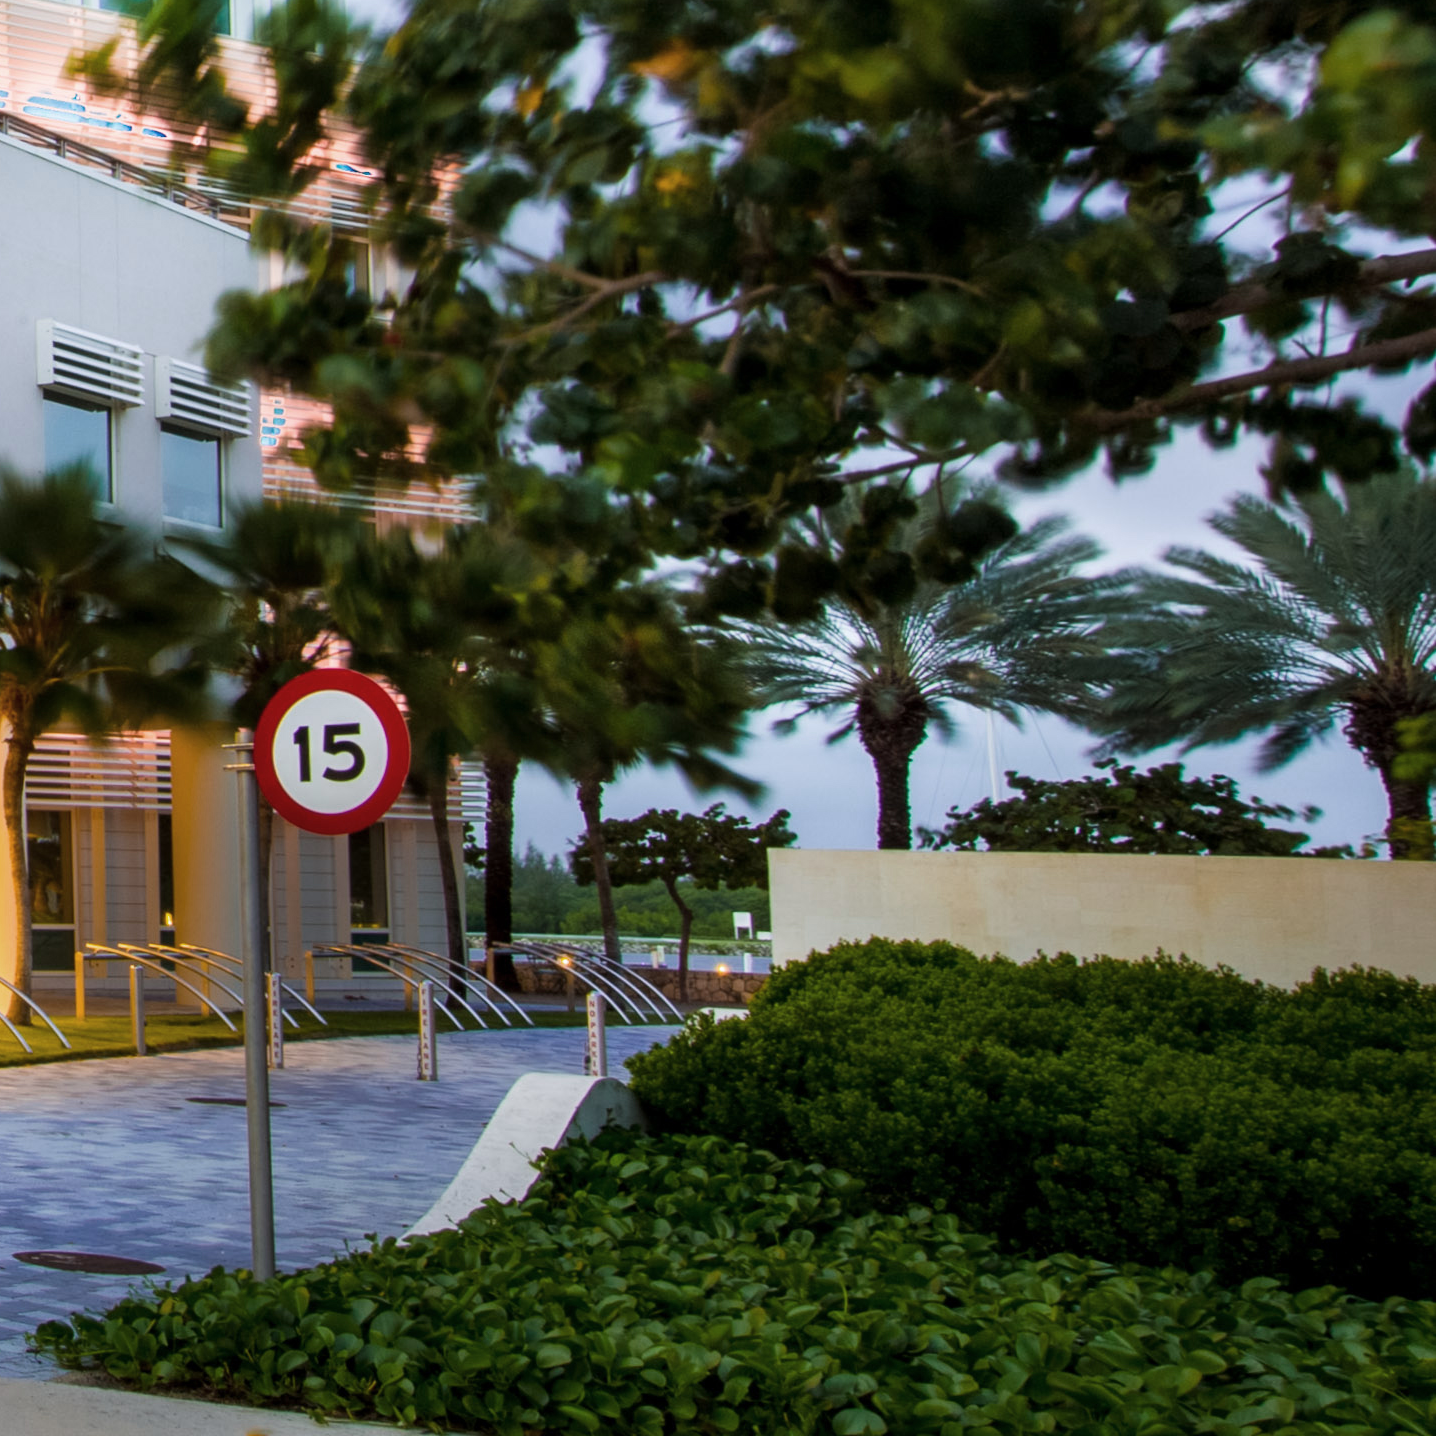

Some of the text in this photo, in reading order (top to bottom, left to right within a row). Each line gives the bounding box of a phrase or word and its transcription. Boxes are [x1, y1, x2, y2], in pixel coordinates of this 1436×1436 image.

[293, 723, 366, 782] 15
[590, 1000, 599, 1076] NO PARKIN
